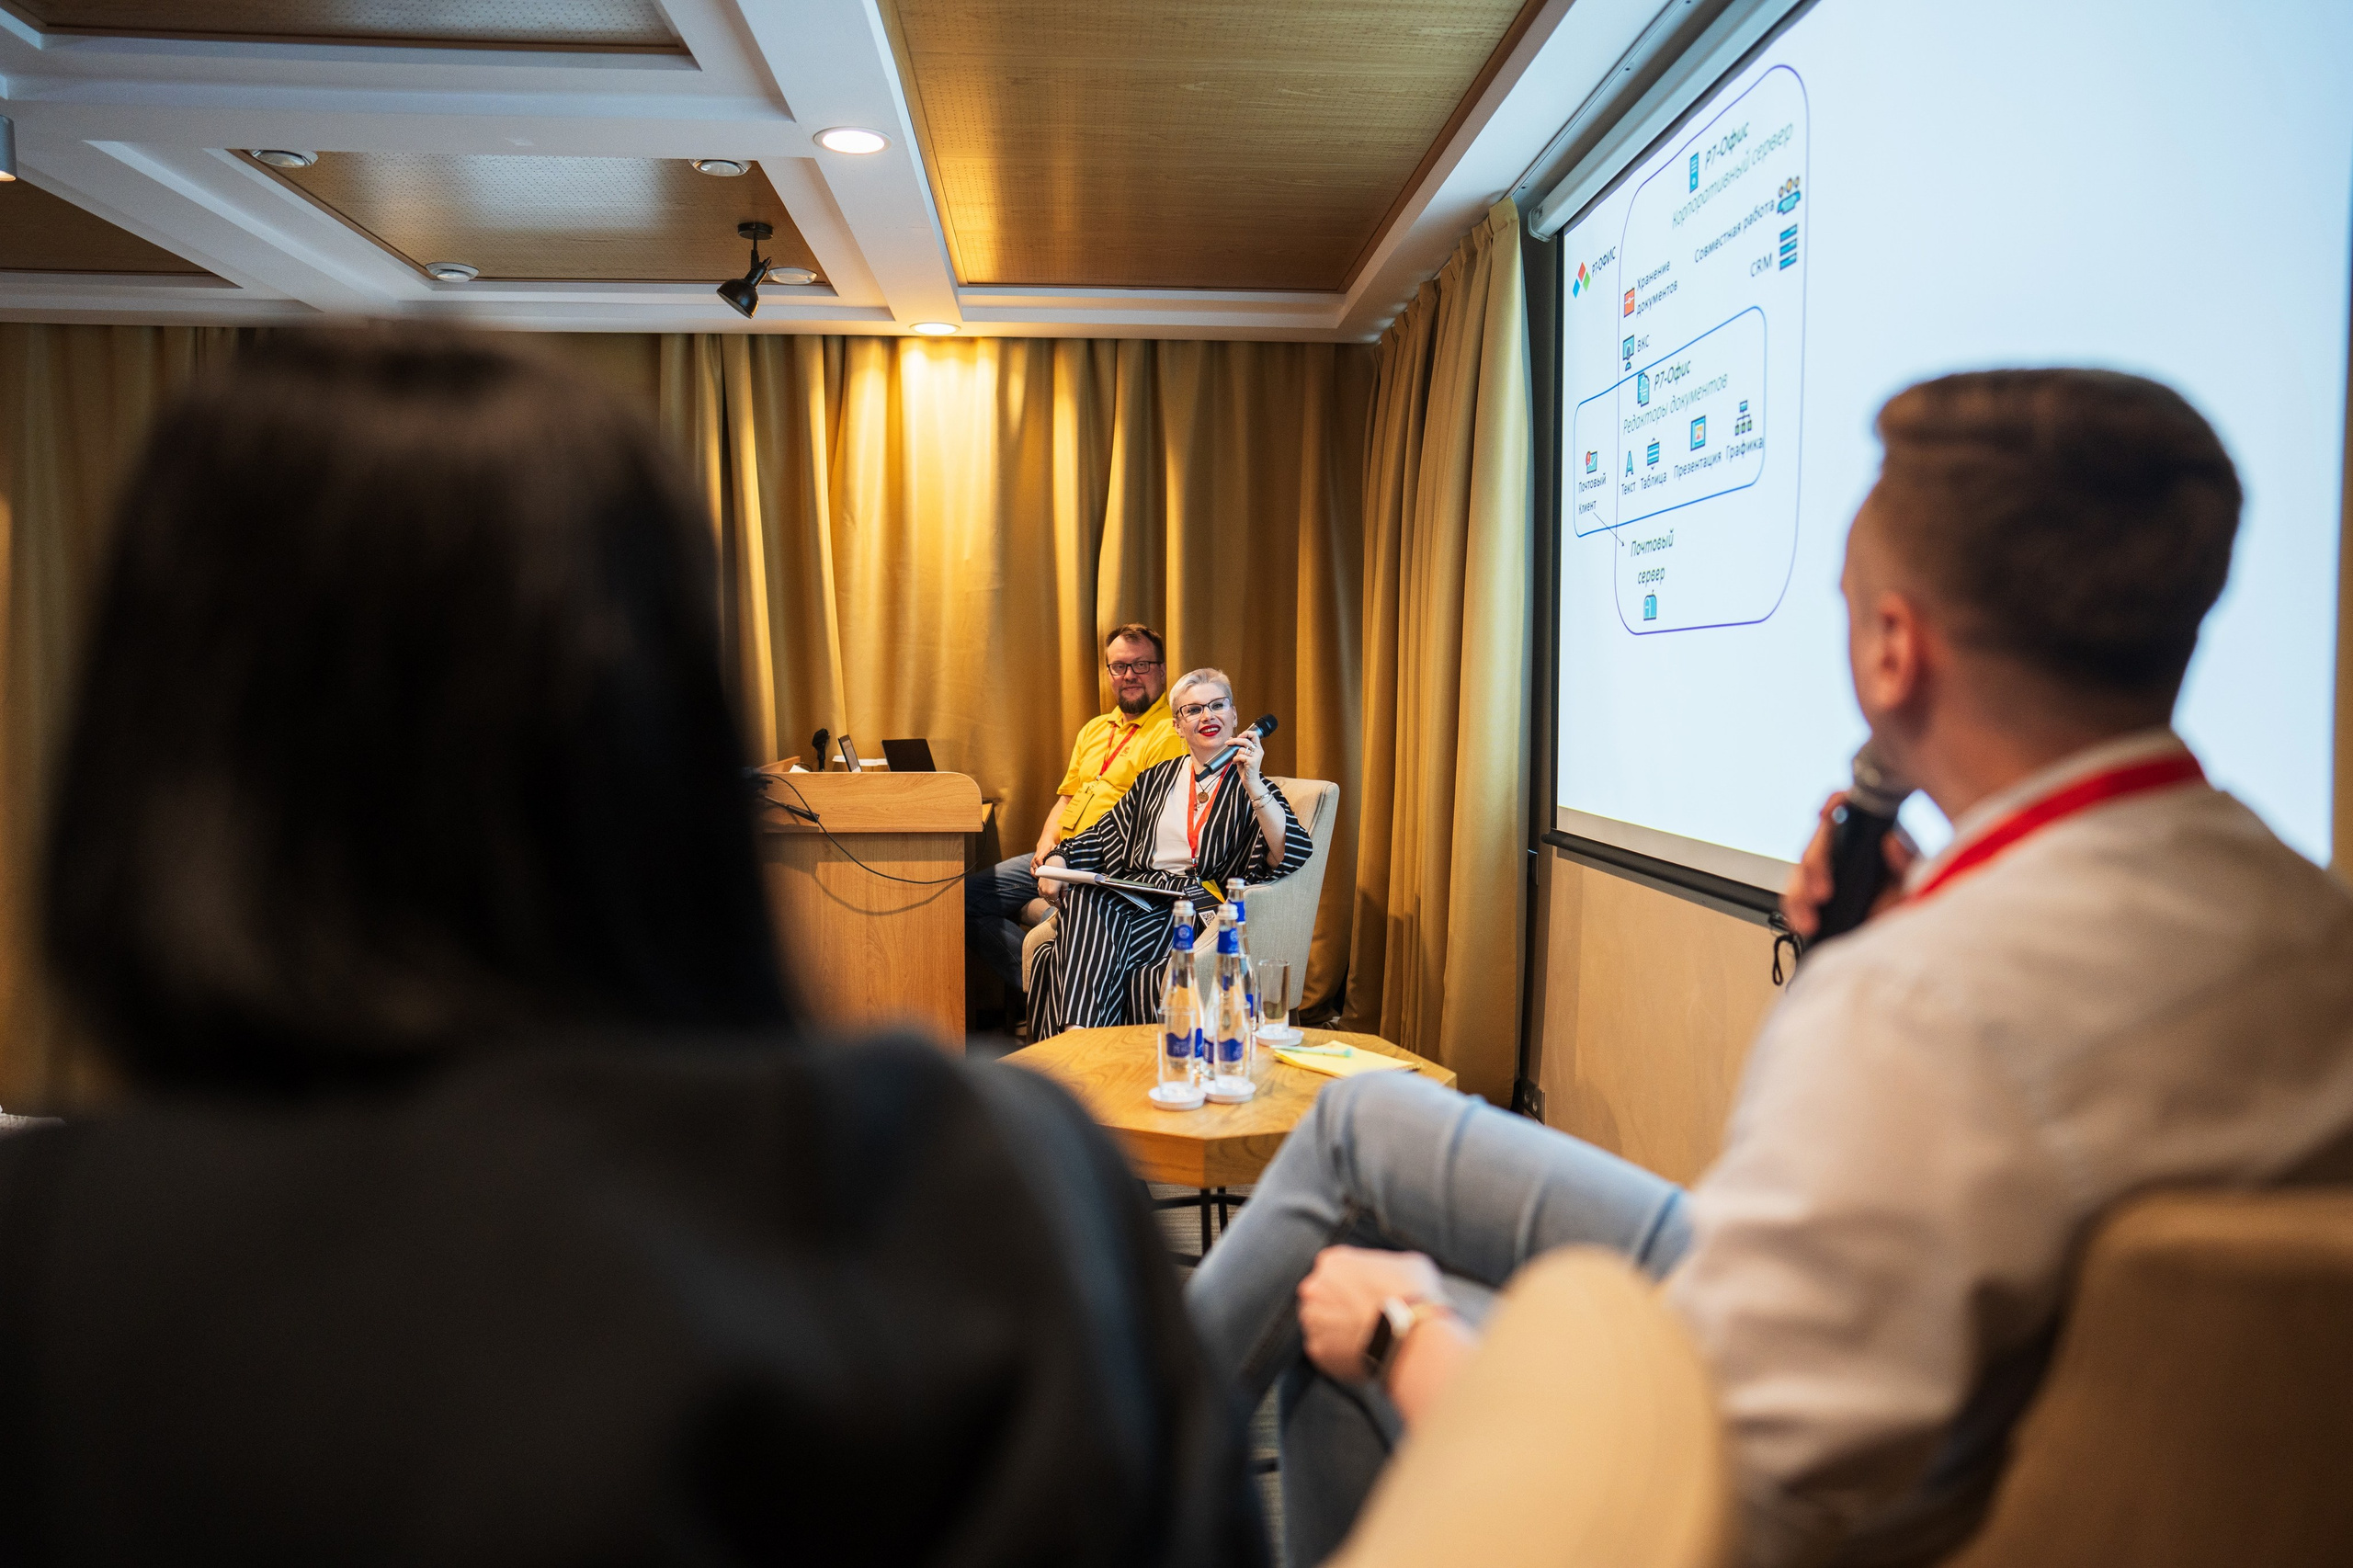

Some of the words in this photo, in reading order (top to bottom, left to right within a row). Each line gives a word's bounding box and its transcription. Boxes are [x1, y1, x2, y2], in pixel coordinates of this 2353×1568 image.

[1672, 148, 1749, 230] Корпоративный
[1751, 123, 1792, 165] сервер
[1694, 222, 1741, 263] Совместная
[1743, 199, 1774, 233] работа
[1636, 261, 1670, 291] Хранение
[1750, 252, 1773, 277] CRM
[1636, 280, 1677, 318] документов
[1637, 335, 1650, 353] ВКС
[1654, 360, 1691, 392] Р7-Офис
[1623, 403, 1668, 436] Редакторы
[1669, 373, 1728, 412] документов
[1725, 438, 1764, 462] Графика
[1673, 451, 1722, 481] Презентация
[1578, 472, 1606, 494] Почтовый
[1620, 482, 1636, 495] Текст
[1640, 472, 1667, 491] Таблица
[1578, 500, 1597, 515] Клиент
[1631, 528, 1674, 557] Почтовый
[1637, 566, 1665, 587] сервер
